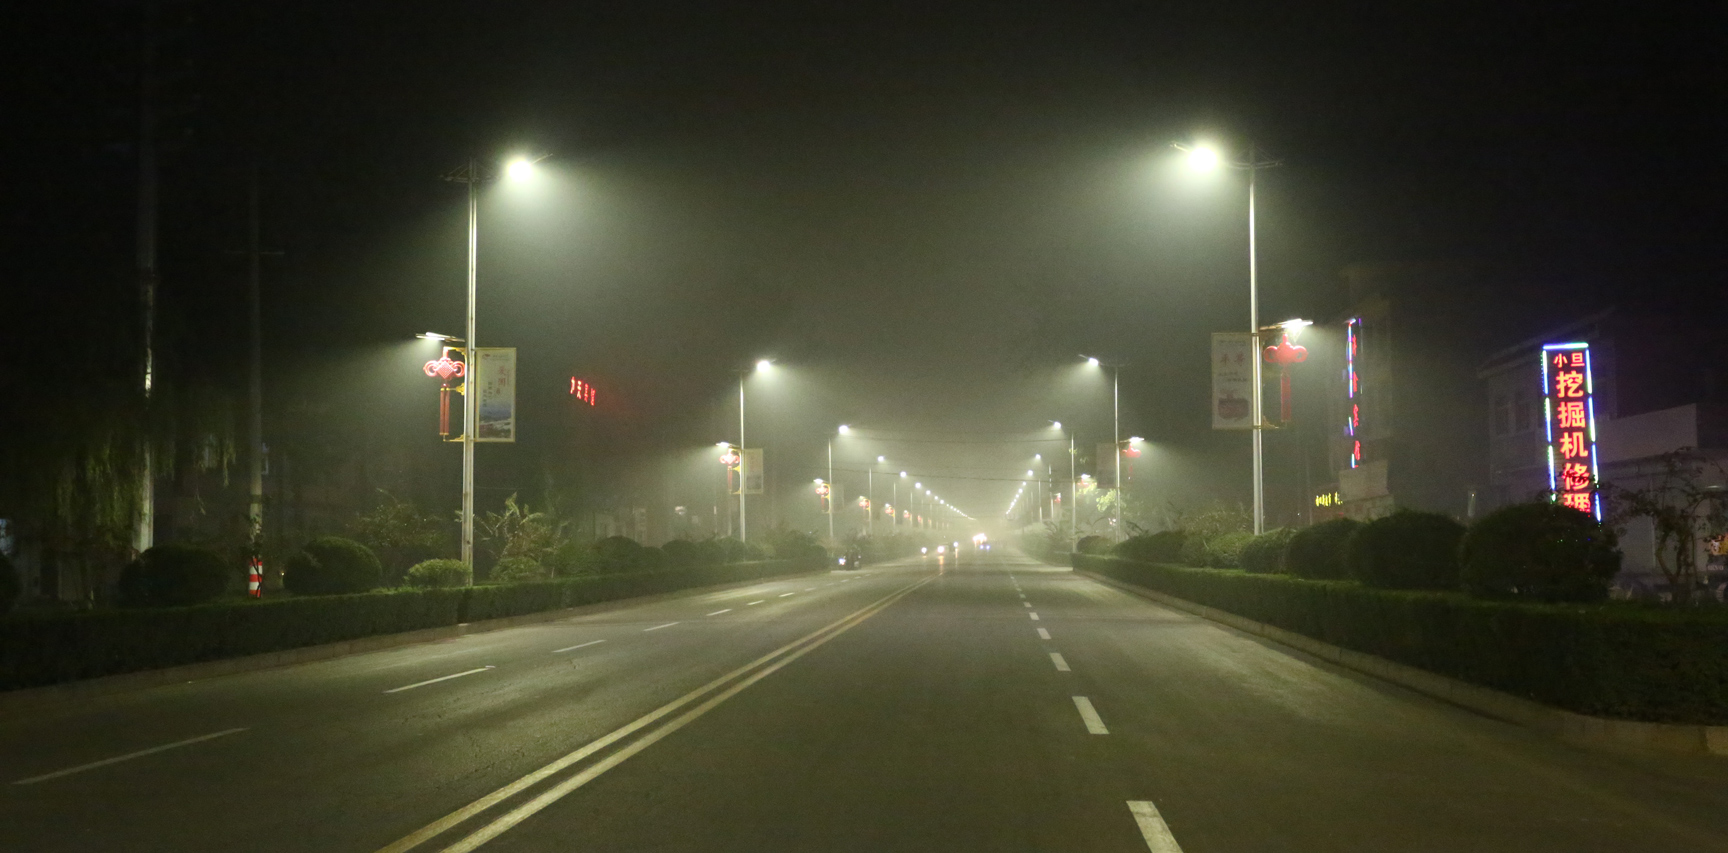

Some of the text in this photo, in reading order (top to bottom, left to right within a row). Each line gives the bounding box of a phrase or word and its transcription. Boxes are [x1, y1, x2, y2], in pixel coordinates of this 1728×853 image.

[1553, 352, 1586, 368] 小旦
[1555, 370, 1591, 514] 挖掘机修理
